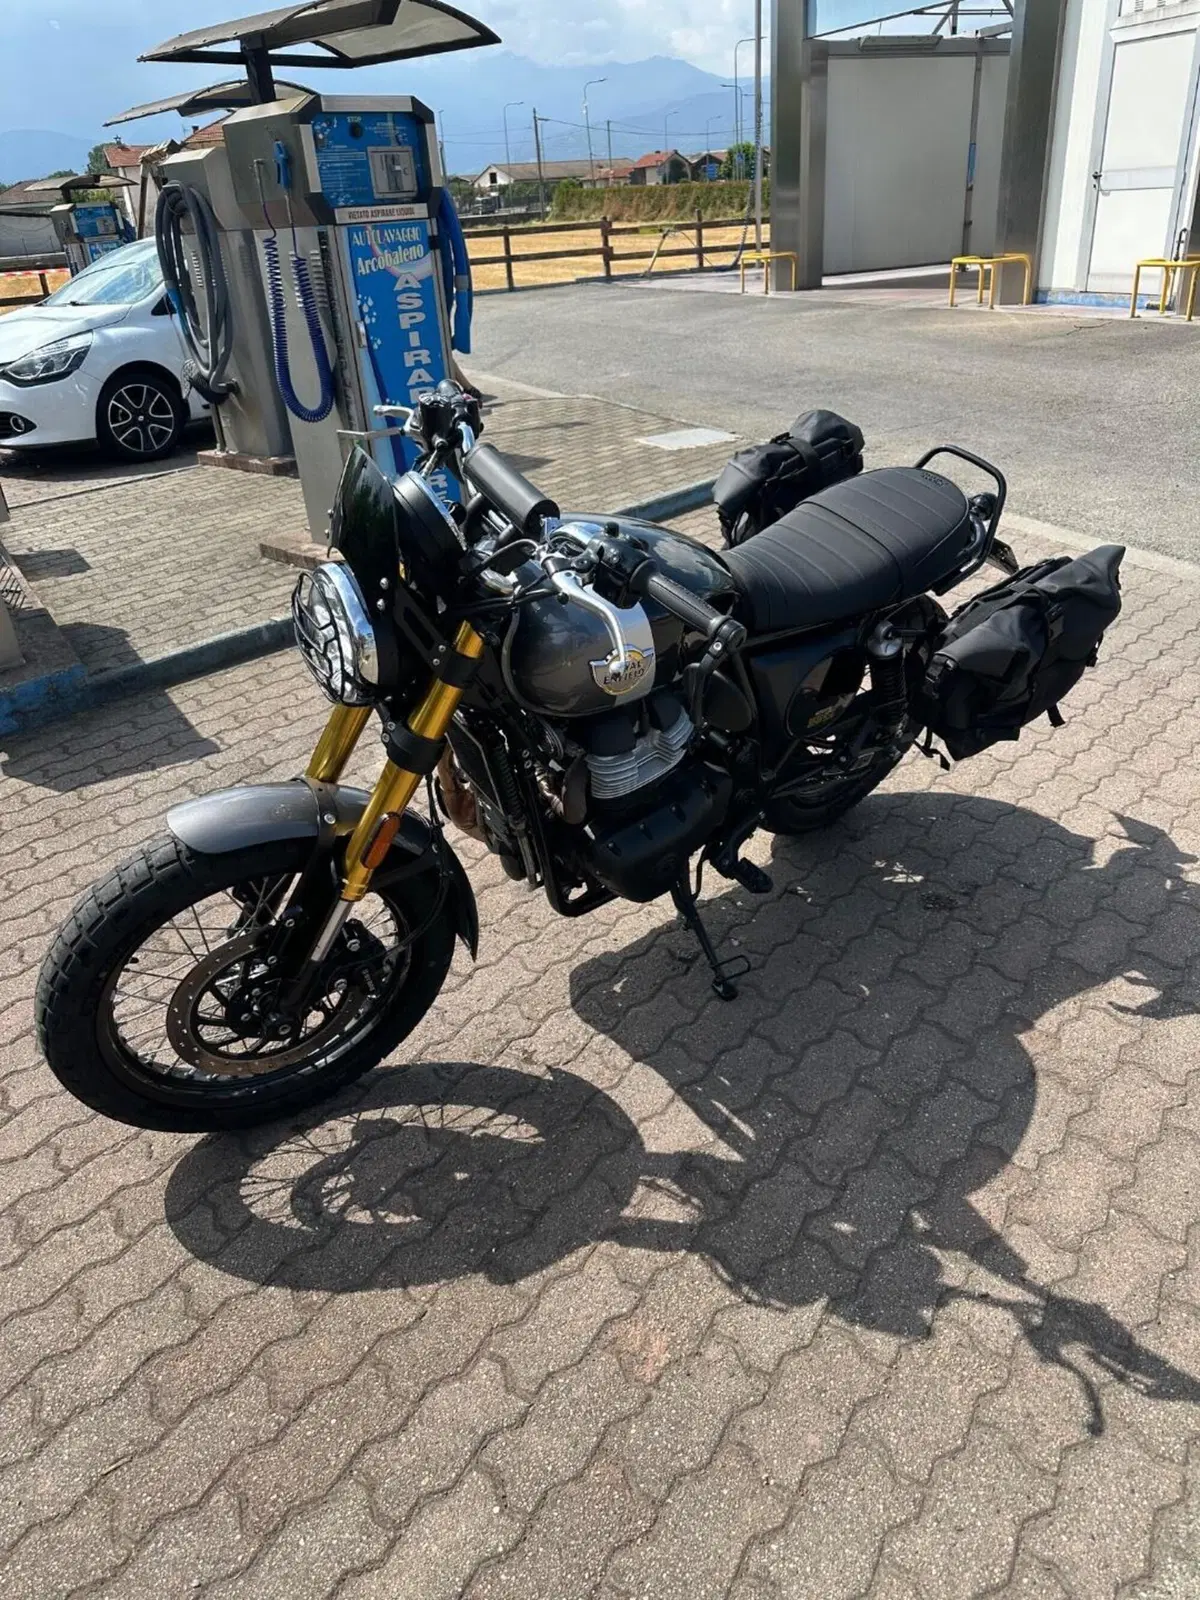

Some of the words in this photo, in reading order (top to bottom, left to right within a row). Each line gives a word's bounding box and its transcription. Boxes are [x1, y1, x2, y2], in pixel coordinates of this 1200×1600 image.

[348, 209, 370, 220] VIETATO
[371, 207, 395, 219] ASPIRARE
[352, 226, 421, 246] AUTOLAVAGGIO
[357, 243, 424, 275] Arcobaleno
